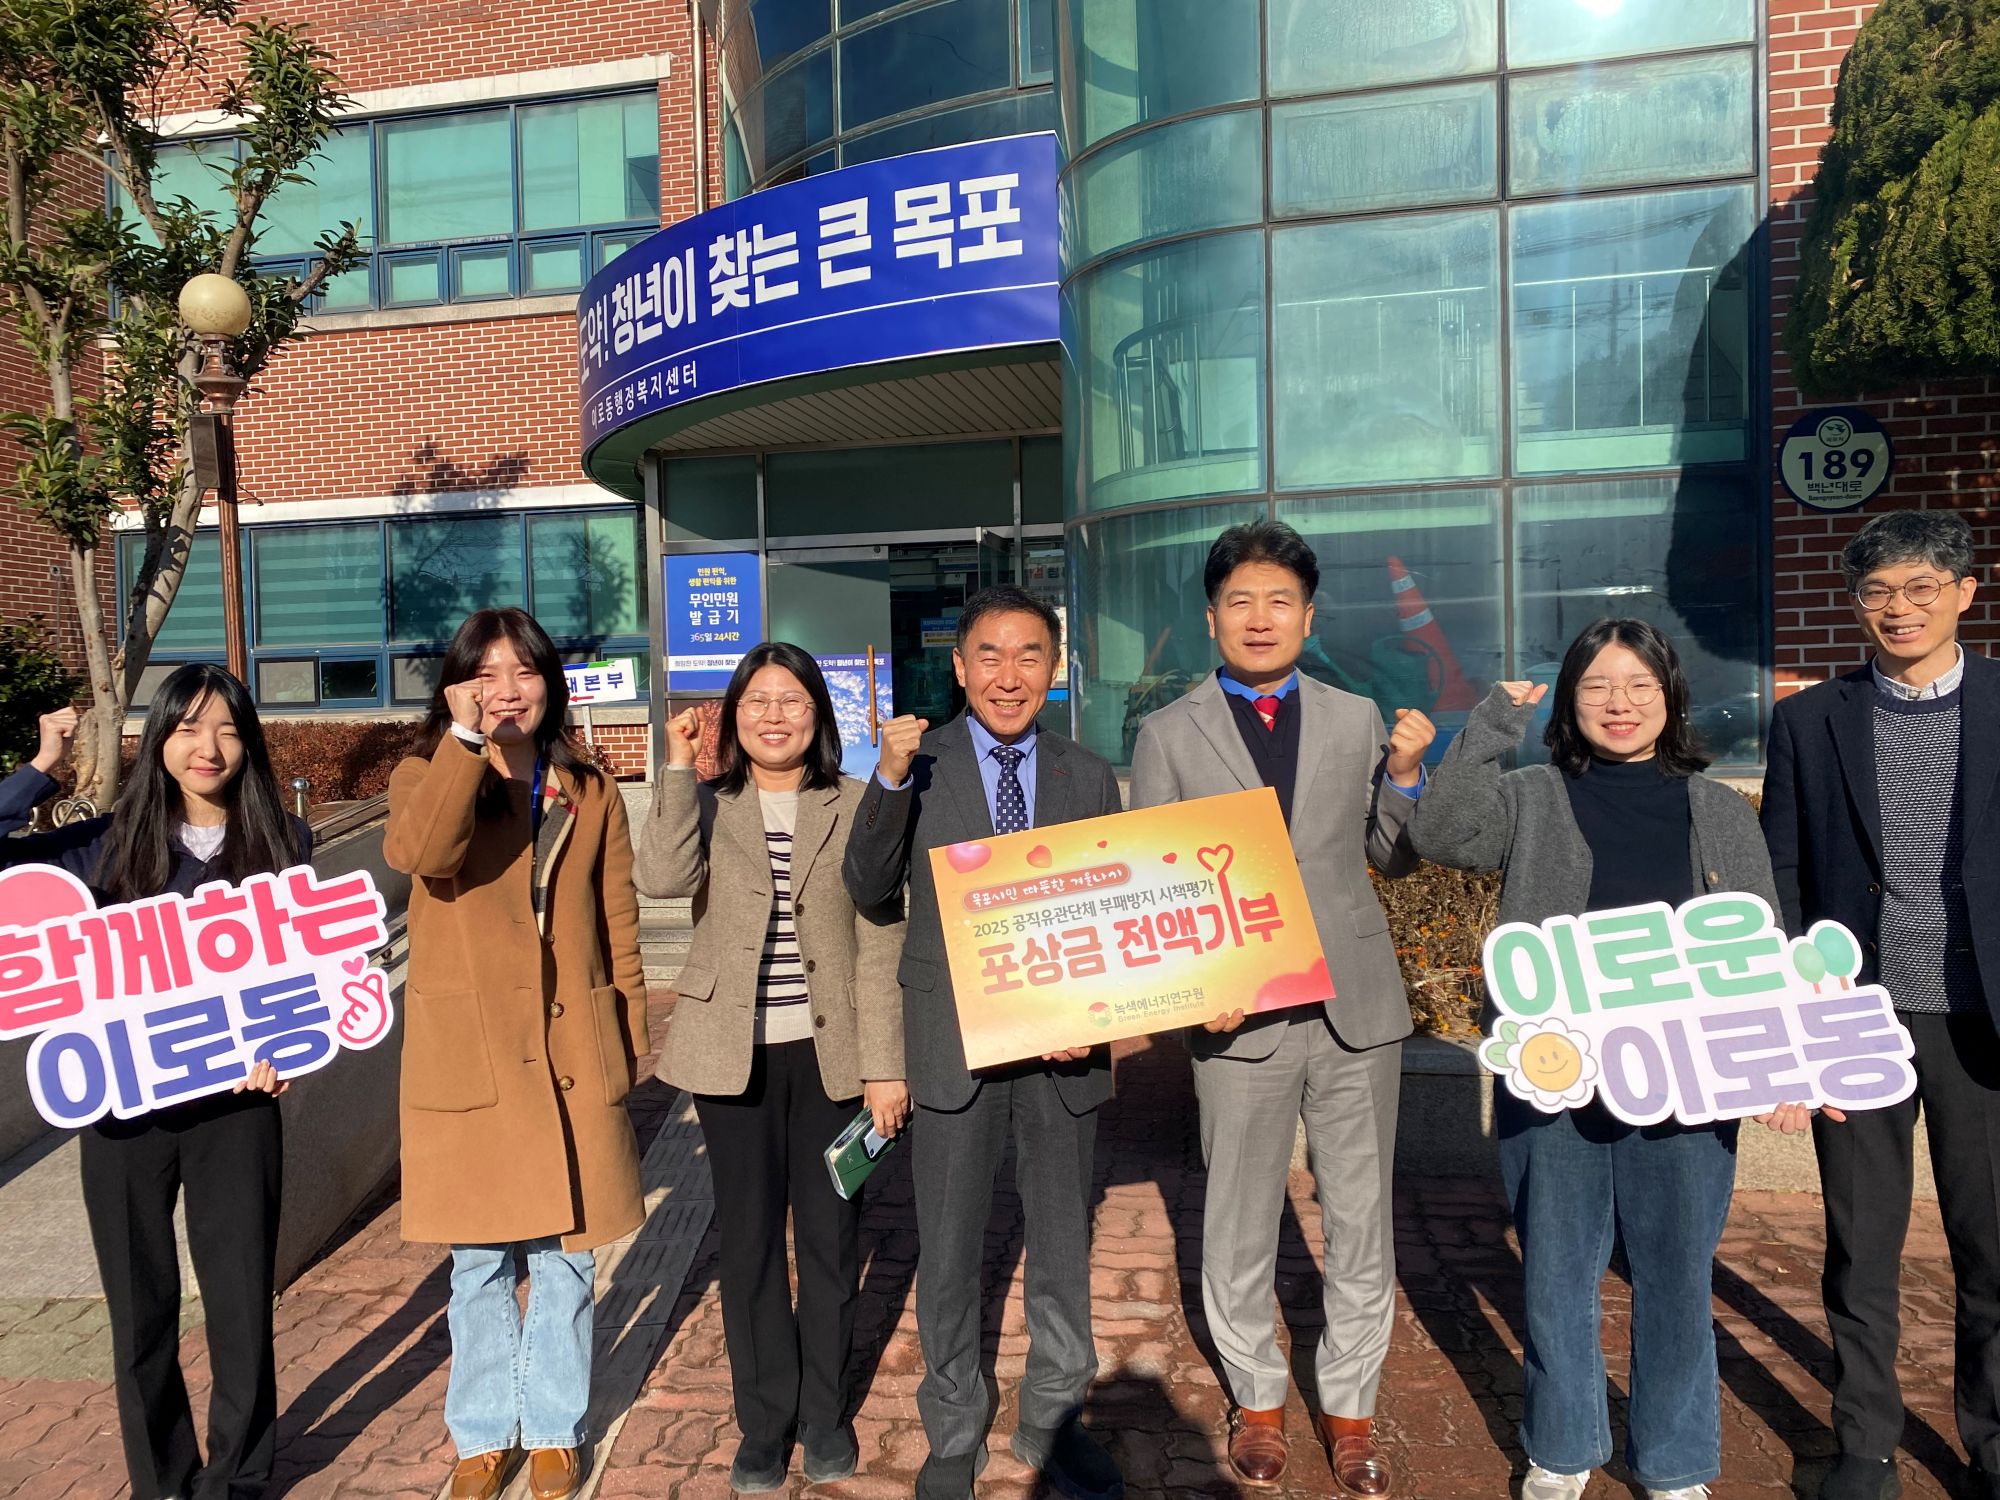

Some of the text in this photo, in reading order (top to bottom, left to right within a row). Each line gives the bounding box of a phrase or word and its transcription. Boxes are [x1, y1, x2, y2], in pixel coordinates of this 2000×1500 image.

[611, 247, 697, 356] 청년이
[708, 222, 800, 317] 찾는
[818, 197, 872, 290] 큰
[893, 172, 1024, 270] 목포
[591, 360, 697, 430] 이로동행정복지센터
[1798, 448, 1875, 480] 189
[1807, 480, 1862, 494] 백년대로
[689, 592, 739, 608] 무인민원
[690, 632, 740, 642] 365일 24시간
[971, 868, 1124, 908] 목포시민 따뜻한 겨울나기
[973, 878, 1216, 938] 2025 공직유관단체 부패방지 시책평가
[0, 872, 380, 1031] 함께하는
[977, 874, 1285, 995] 포상금 전액기부
[1492, 900, 1787, 1017] 이로운
[1114, 986, 1205, 1015] 녹색에너지연구원
[38, 973, 332, 1119] 이로동
[1600, 994, 1907, 1117] 이로동
